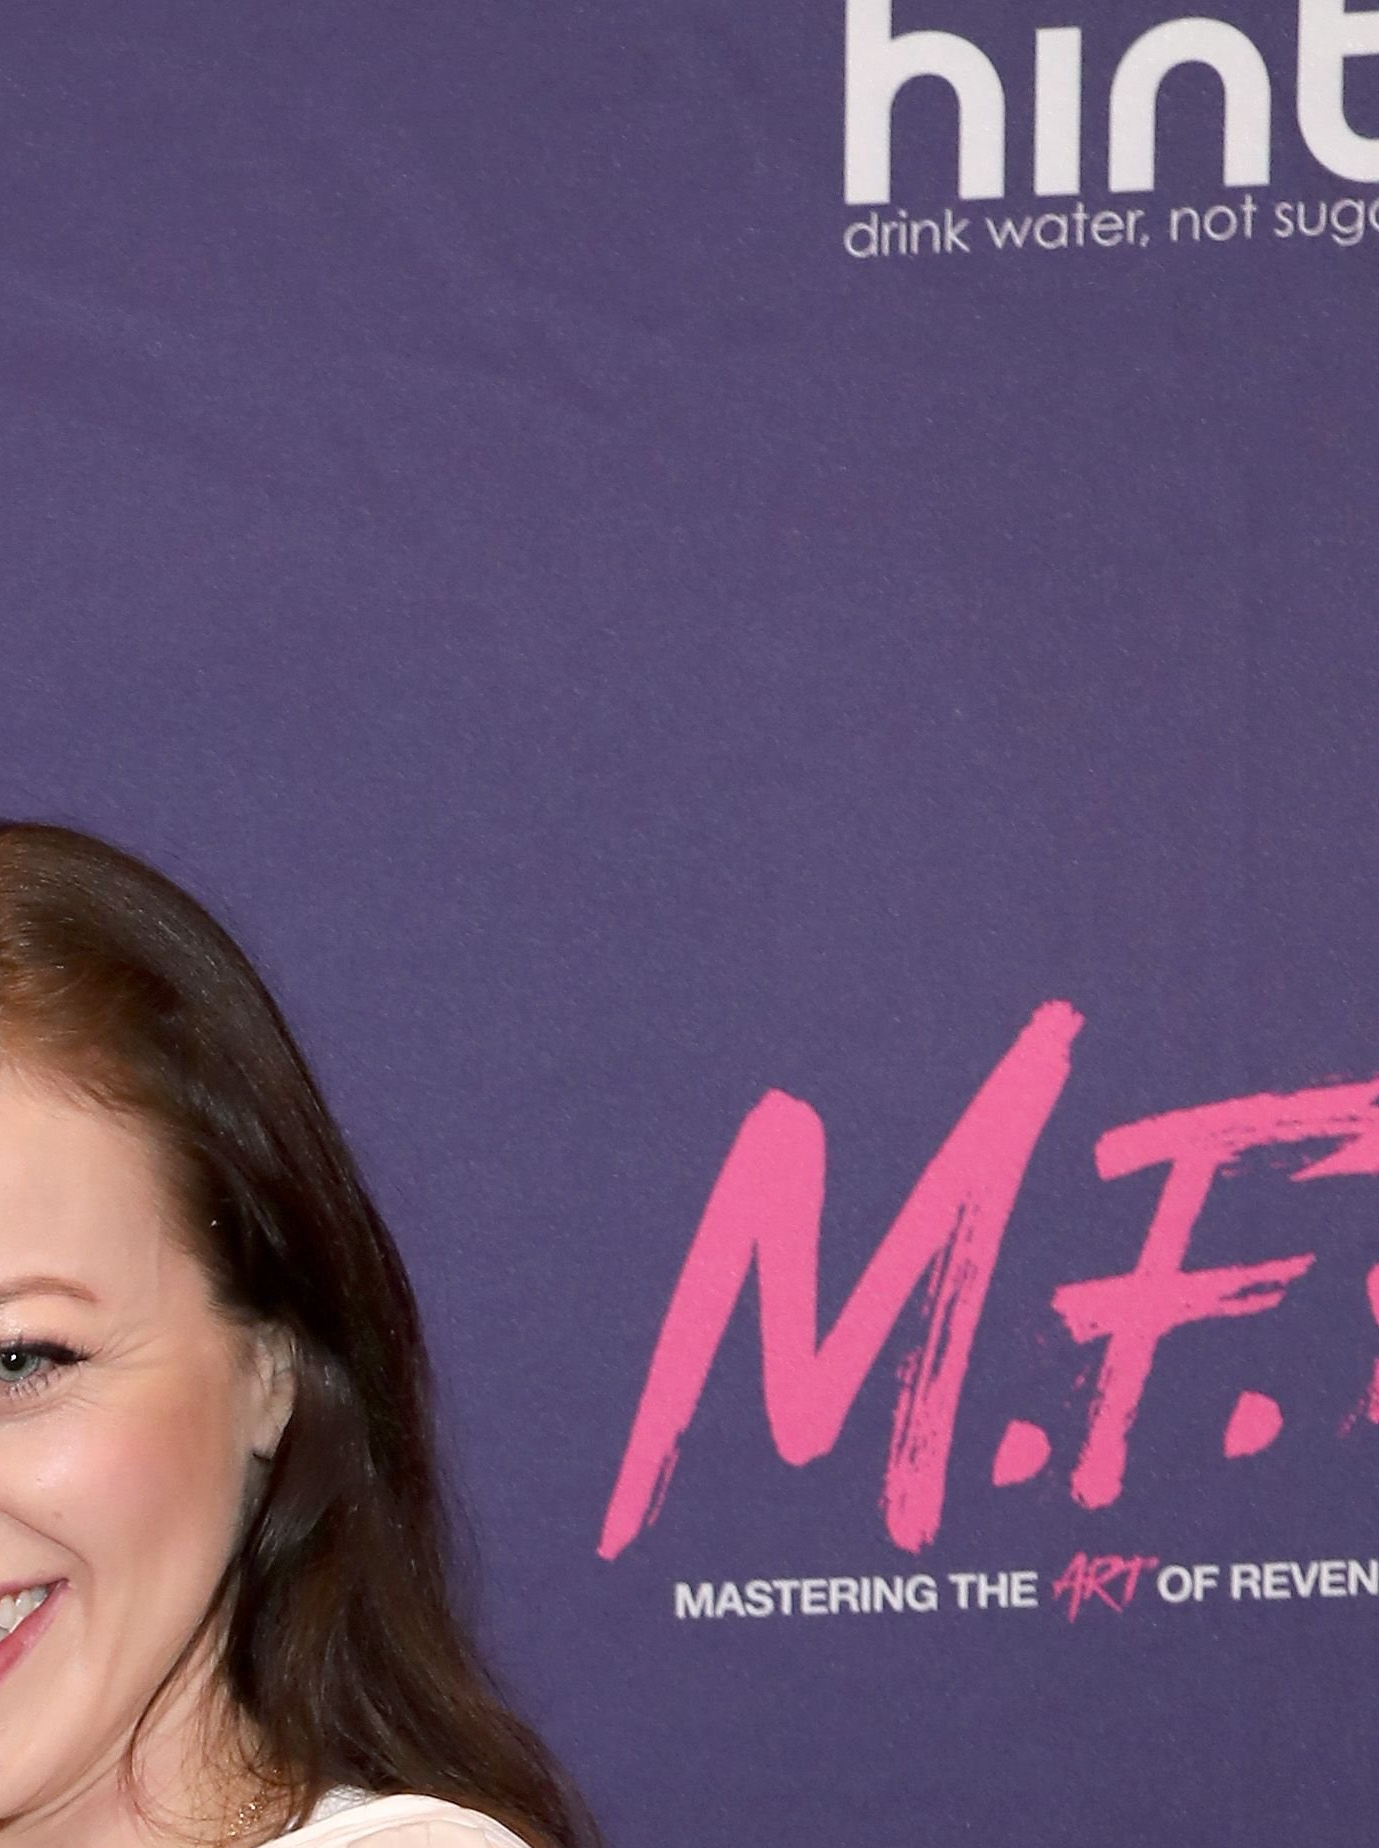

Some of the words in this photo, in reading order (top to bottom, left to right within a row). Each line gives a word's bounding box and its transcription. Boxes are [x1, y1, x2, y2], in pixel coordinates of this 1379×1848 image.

[844, 209, 972, 258] drink
[986, 203, 1150, 249] water,
[1170, 193, 1258, 242] not
[597, 1000, 1379, 1560] M.F.
[674, 1573, 938, 1619] MASTERING
[949, 1570, 1038, 1608] THE
[1052, 1551, 1159, 1622] ART
[1156, 1564, 1220, 1603] OF
